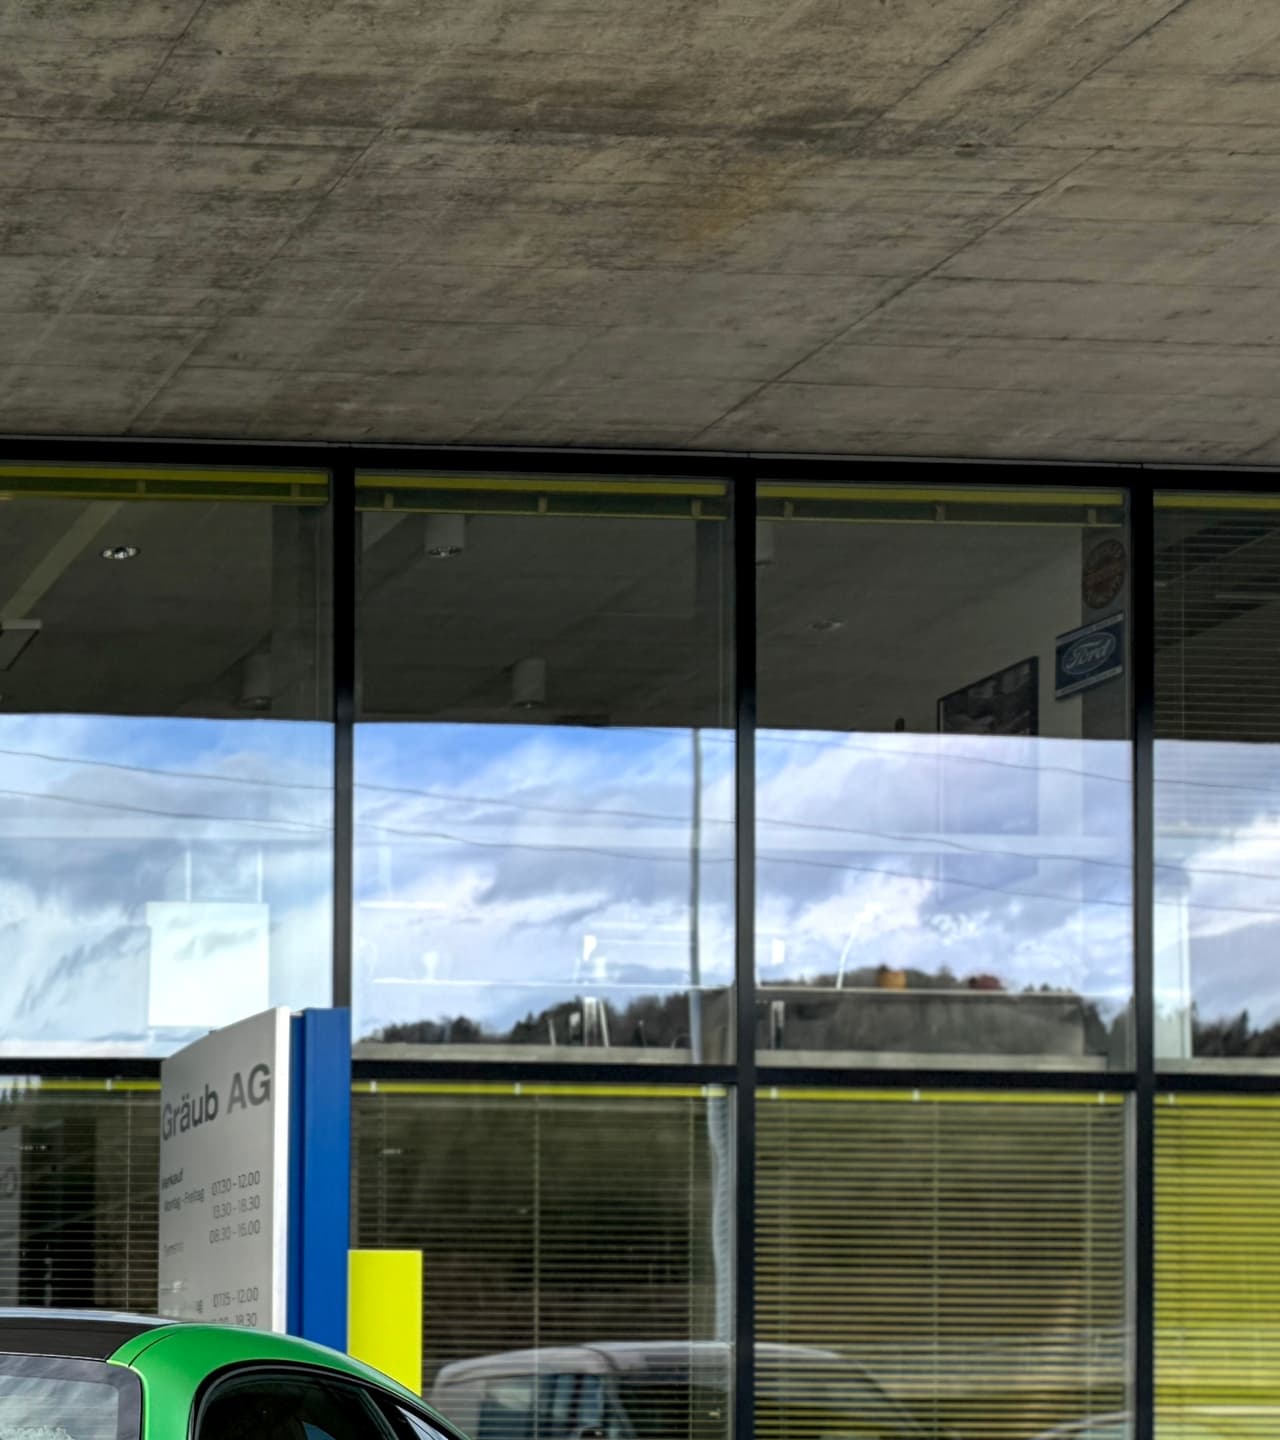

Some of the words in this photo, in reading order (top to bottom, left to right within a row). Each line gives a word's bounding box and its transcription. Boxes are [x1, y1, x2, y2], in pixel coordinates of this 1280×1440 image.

[1065, 639, 1112, 669] Ford
[163, 1084, 219, 1141] Gräub
[226, 1063, 271, 1115] AG
